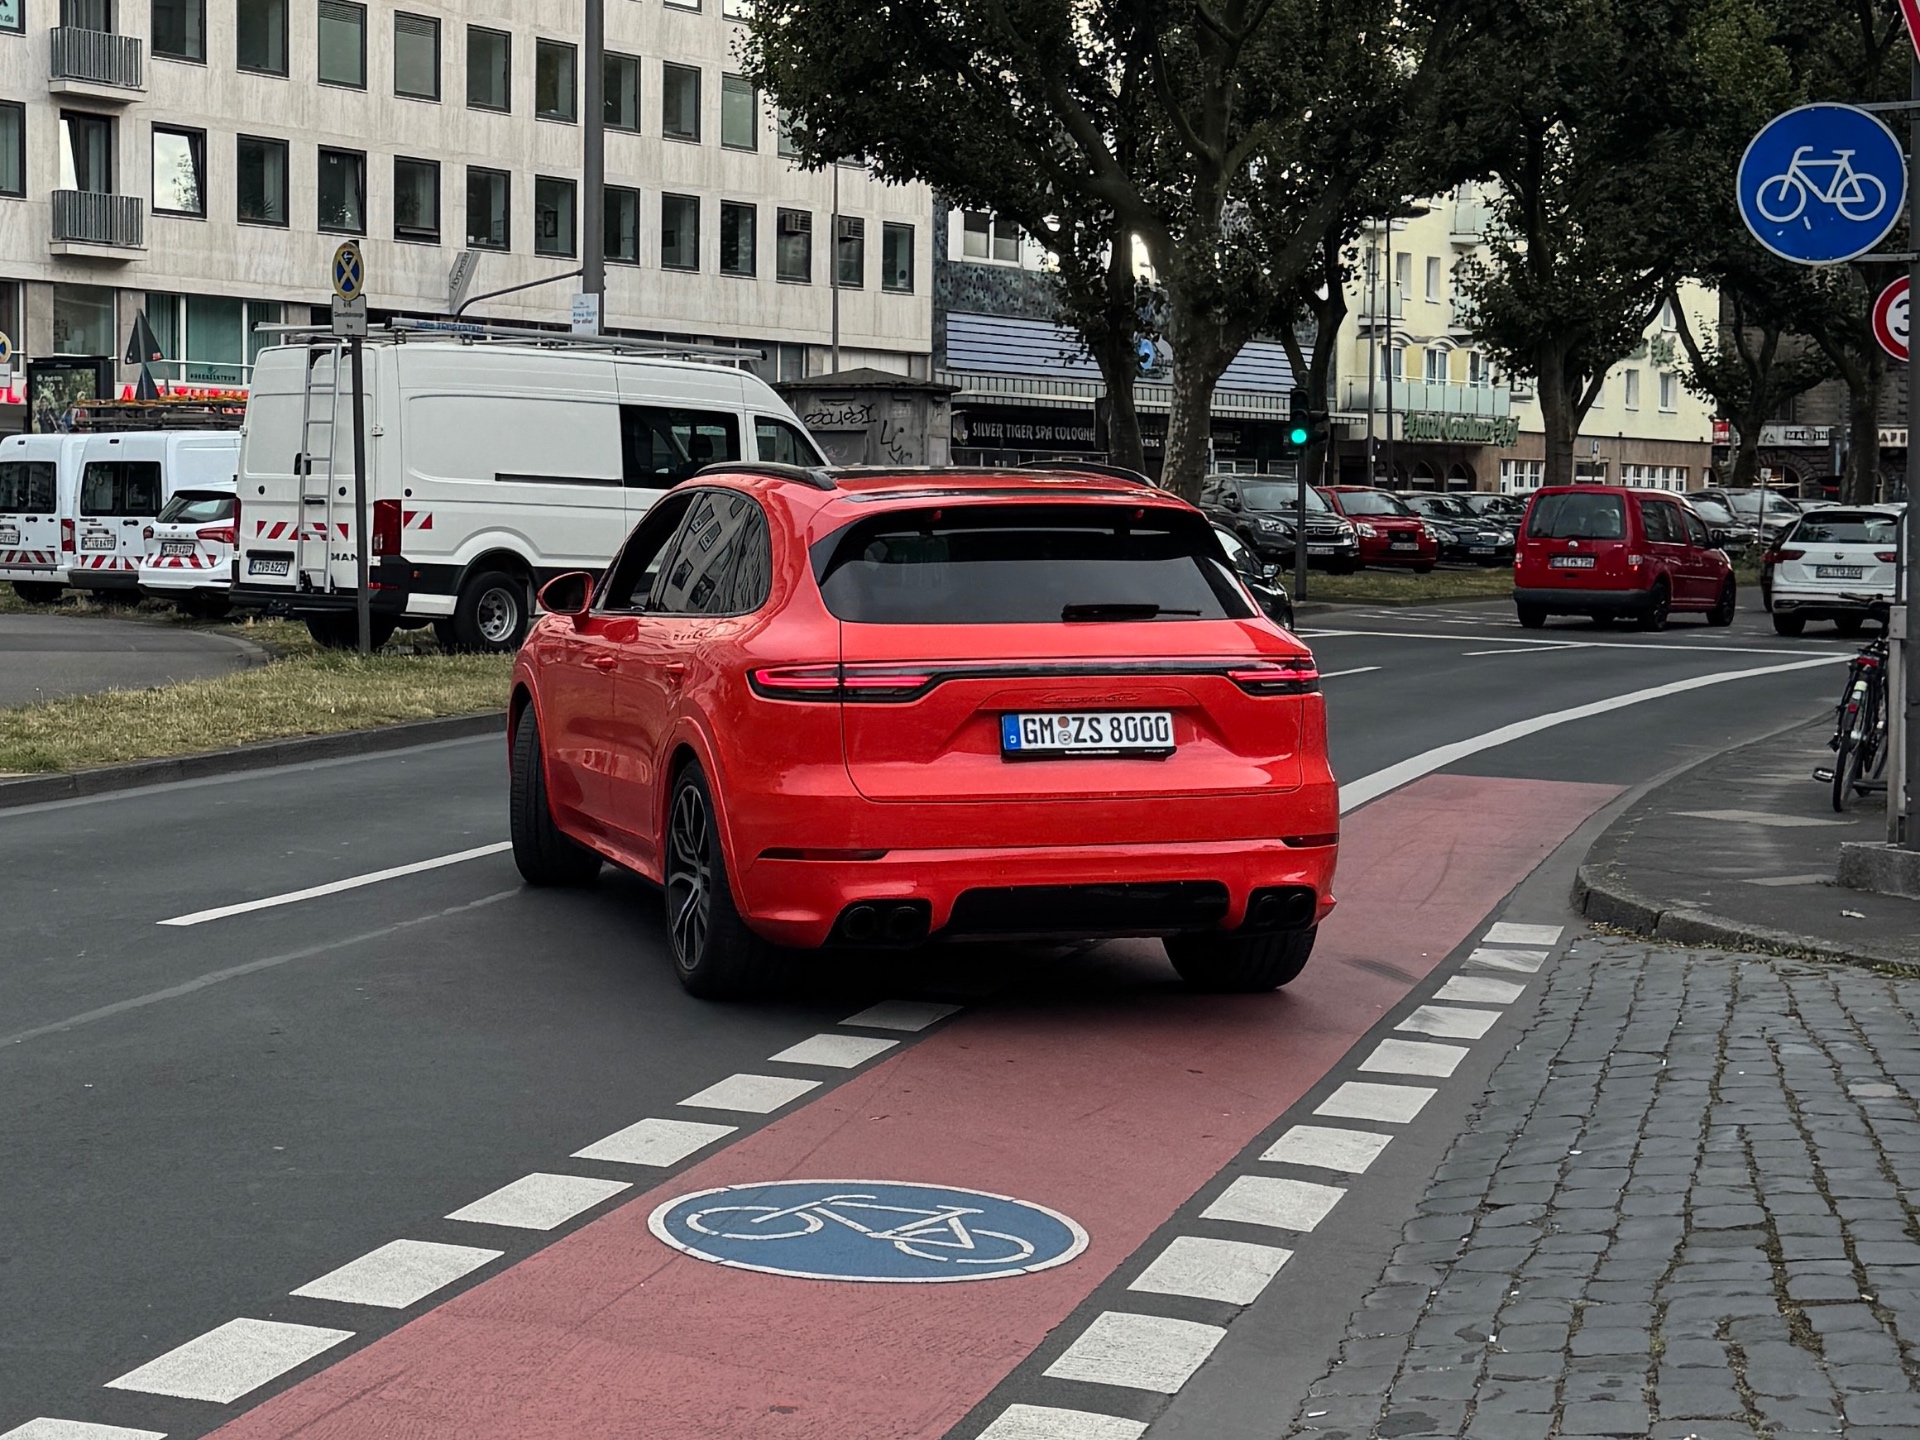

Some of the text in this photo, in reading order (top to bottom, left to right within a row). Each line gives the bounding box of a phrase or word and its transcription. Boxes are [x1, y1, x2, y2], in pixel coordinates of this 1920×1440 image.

[972, 422, 1003, 438] SILVER
[1005, 423, 1033, 440] TIGER
[1035, 425, 1052, 440] SPA
[1023, 717, 1055, 744] GM
[1072, 716, 1103, 744] ZS
[1110, 715, 1169, 743] 8000
